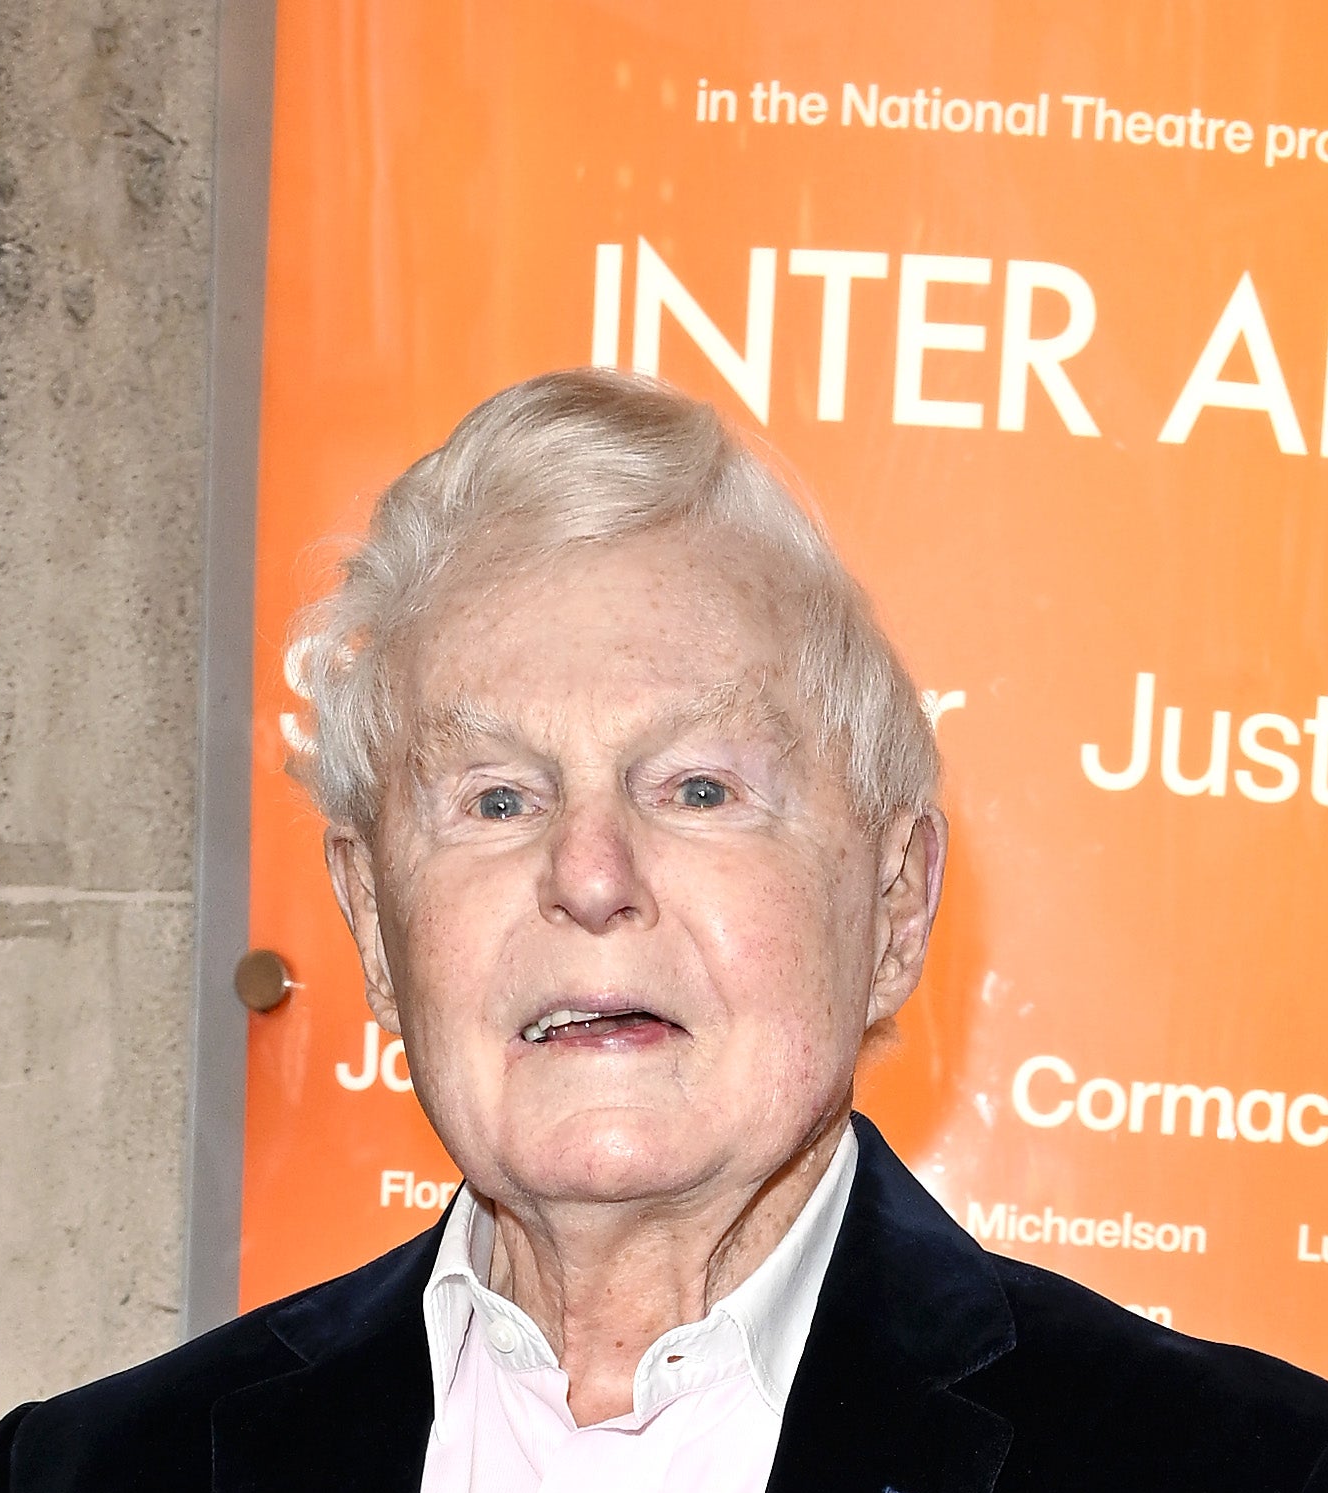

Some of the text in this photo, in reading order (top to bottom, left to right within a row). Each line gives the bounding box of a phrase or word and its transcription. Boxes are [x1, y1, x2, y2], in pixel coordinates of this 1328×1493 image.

[697, 79, 737, 121] in
[750, 80, 828, 125] the
[842, 83, 1049, 136] National
[1062, 95, 1253, 152] Theatre
[591, 236, 1100, 437] INTER
[380, 1169, 456, 1209] Flor
[968, 1201, 1207, 1254] Michaelson
